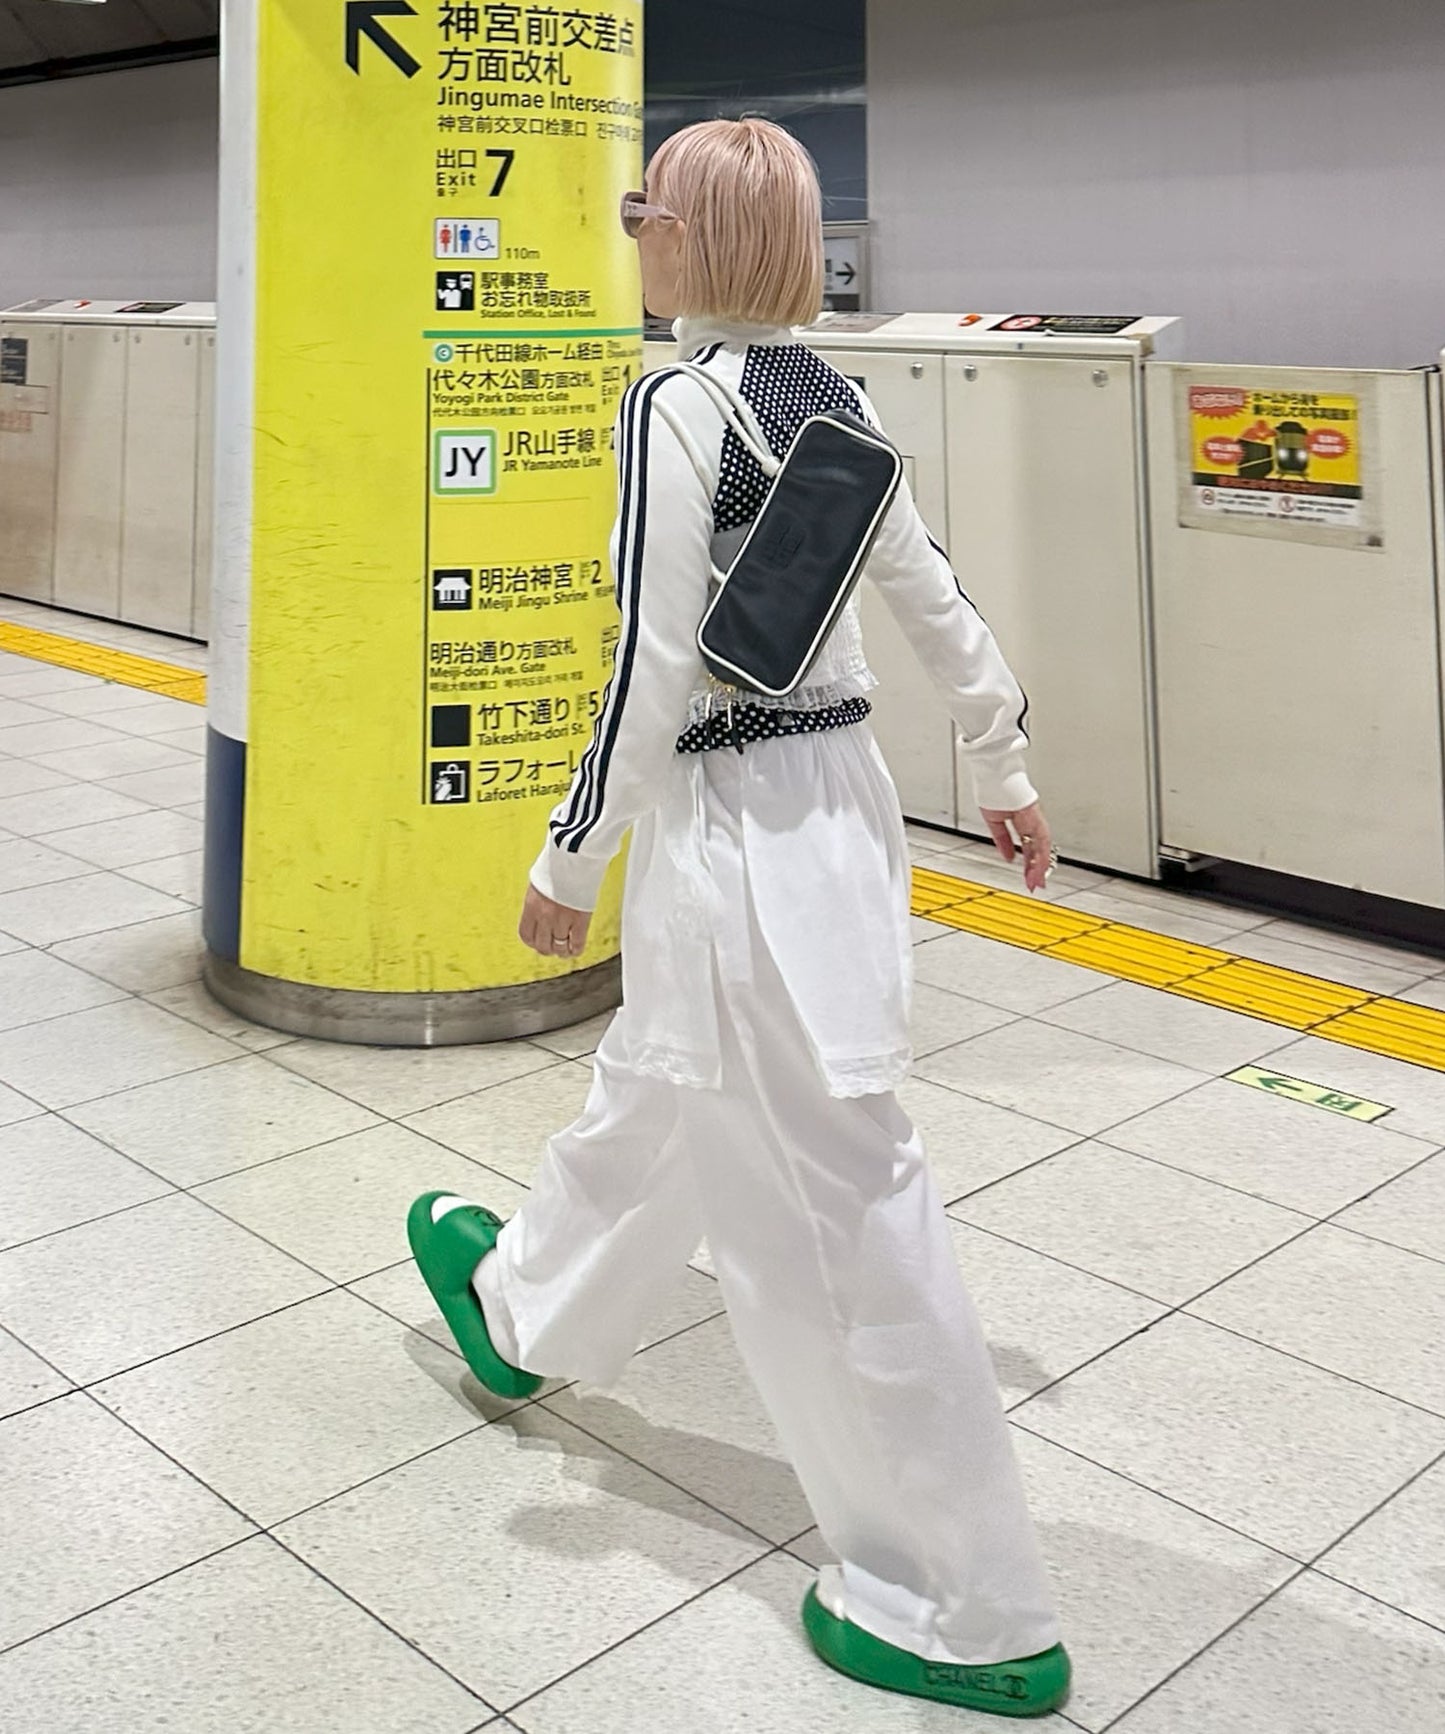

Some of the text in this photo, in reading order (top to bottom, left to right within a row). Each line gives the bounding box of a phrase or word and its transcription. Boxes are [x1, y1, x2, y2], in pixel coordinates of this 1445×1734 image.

[438, 1, 635, 57] 神宮前交差点
[438, 47, 571, 86] 方面改札
[437, 86, 544, 111] Jingumae
[550, 91, 631, 117] Intersection
[436, 148, 477, 168] 出口
[436, 172, 476, 186] Exit
[485, 149, 515, 197] 7
[505, 248, 540, 259] 110m
[481, 272, 549, 289] 駅事務室
[481, 290, 591, 308] お忘れ物取扱所
[481, 309, 515, 318] Station
[517, 309, 546, 319] Office,
[548, 310, 565, 318] Lost
[574, 309, 596, 317] Found
[455, 343, 603, 363] 千代田線ホーム経由
[433, 391, 569, 405] Yoyogi Park District Gate
[602, 385, 619, 397] Exit
[503, 428, 596, 456] JR山手線
[445, 447, 487, 477] JY
[503, 455, 602, 472] JR Yamanote Line
[479, 563, 573, 594] 明治神宮
[591, 560, 602, 584] 2
[479, 596, 514, 612] Meiji
[516, 592, 550, 610] Jingu
[553, 590, 588, 605] Shrine
[430, 637, 577, 665] 明治通り方面改札
[430, 662, 546, 680] Meiji-dori Ave. Gate
[478, 697, 571, 731] 竹下通り
[588, 690, 599, 717] 5
[476, 722, 587, 746] Takeshita-dori St.
[476, 779, 571, 803] Laforet Haraju
